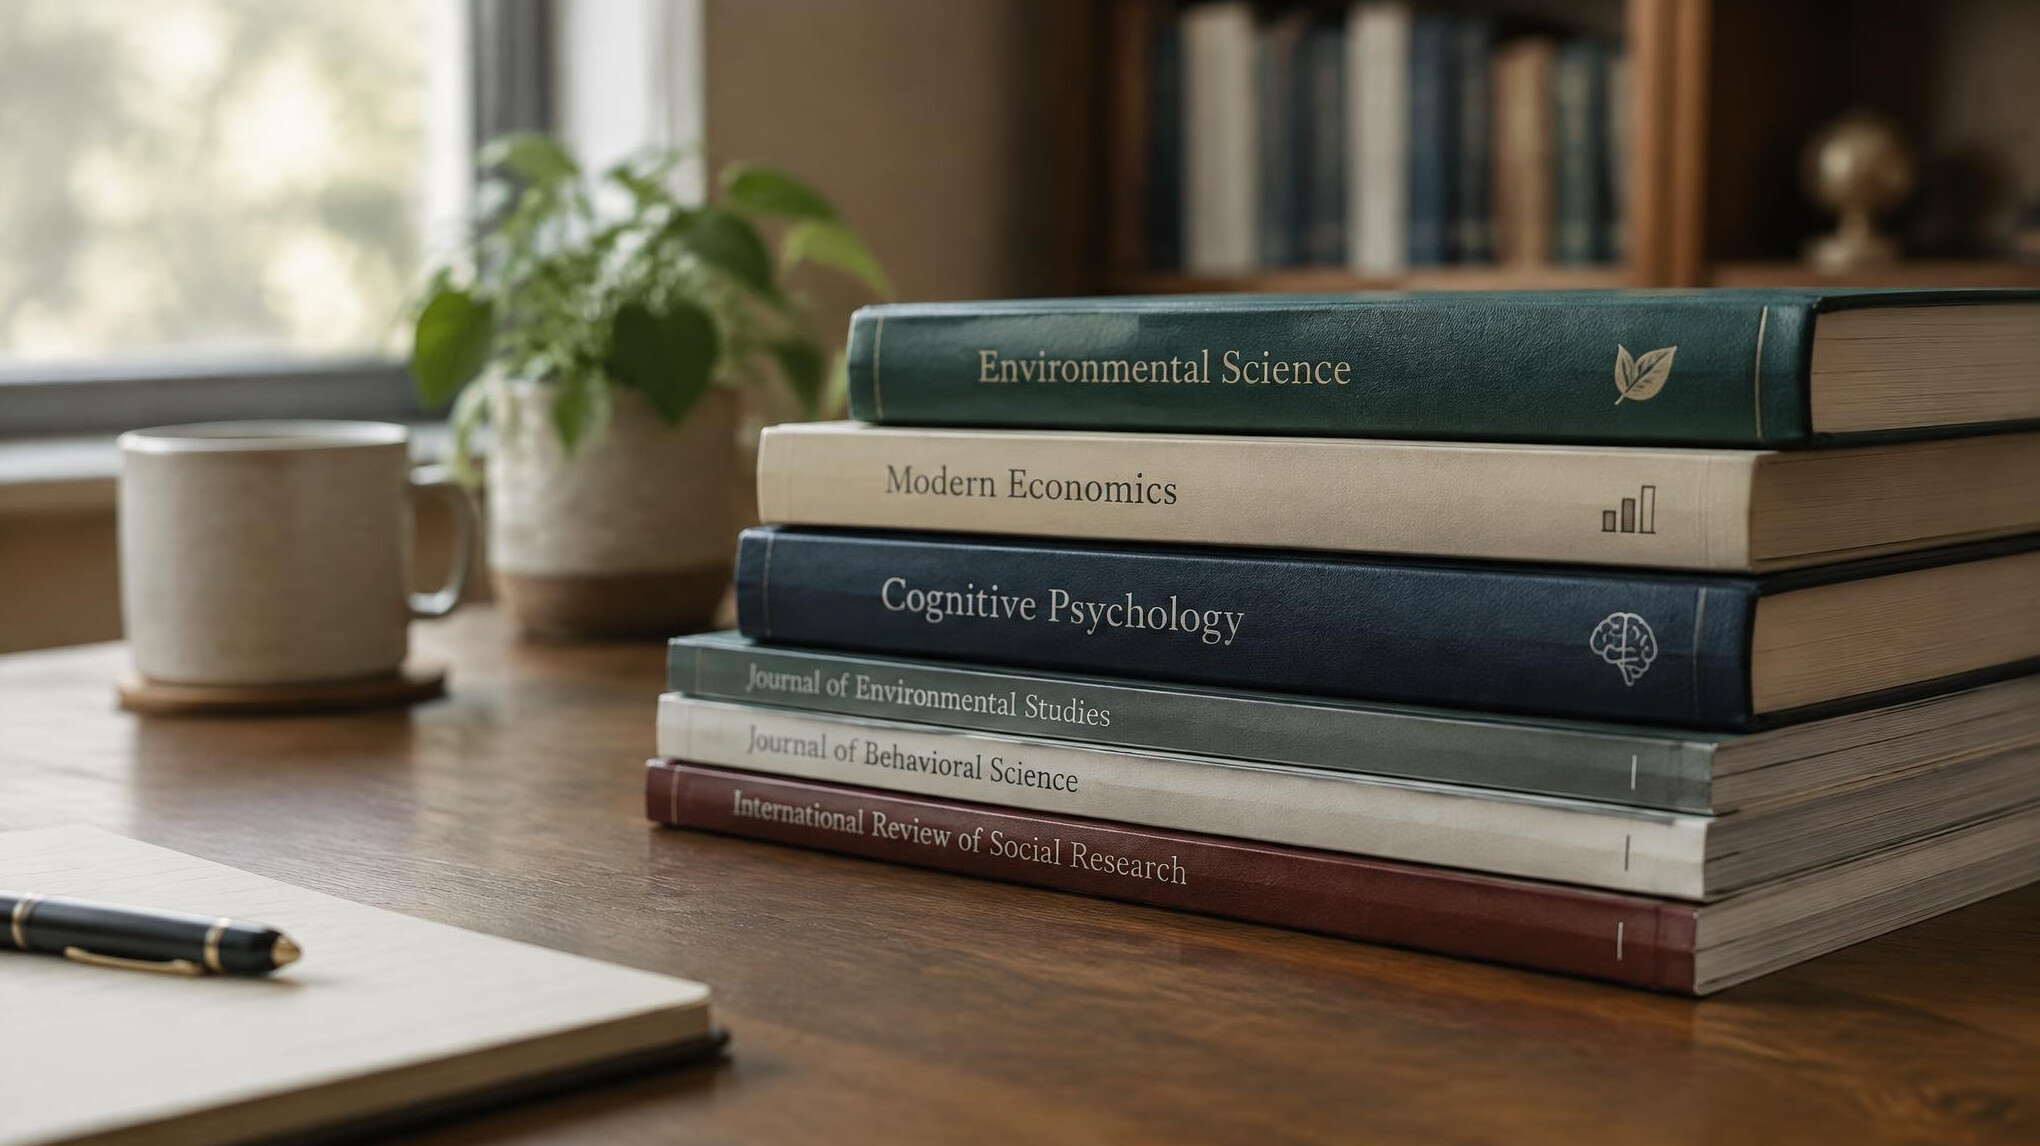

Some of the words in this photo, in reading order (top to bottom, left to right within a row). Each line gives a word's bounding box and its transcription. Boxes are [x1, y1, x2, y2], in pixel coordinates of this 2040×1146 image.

[978, 349, 1211, 385] Environmental
[1221, 350, 1352, 386] Science
[885, 464, 997, 498] Modern
[1008, 468, 1178, 505] Economics
[881, 576, 1036, 624] Cognitive
[1048, 587, 1245, 646] Psychology
[745, 663, 820, 695] Journal
[826, 672, 850, 698] of
[856, 677, 1017, 718] Environmental
[1025, 693, 1111, 728] Studies
[746, 725, 827, 760] Journal
[834, 735, 860, 762] of
[866, 741, 983, 781] Behavioral
[990, 756, 1079, 794] Science
[733, 789, 864, 836] International
[872, 810, 952, 849] Review
[958, 826, 983, 853] of
[990, 829, 1061, 867] Social
[1071, 840, 1188, 886] Research
